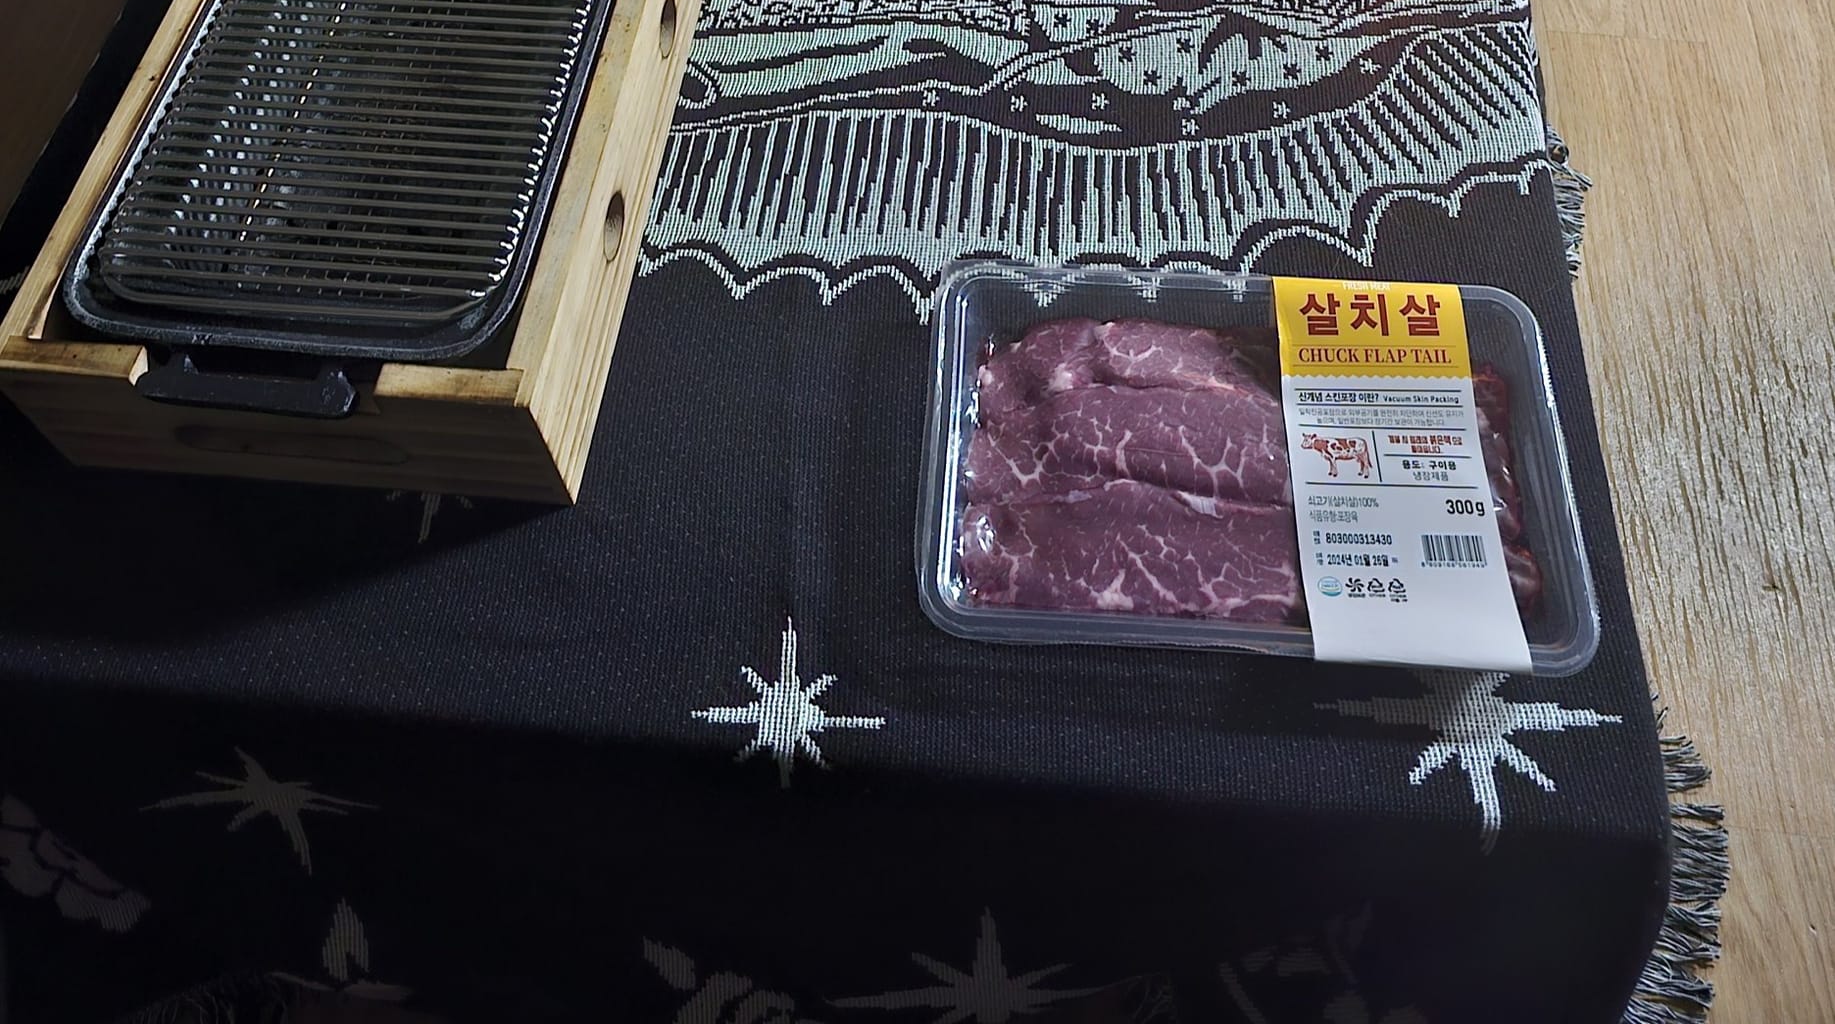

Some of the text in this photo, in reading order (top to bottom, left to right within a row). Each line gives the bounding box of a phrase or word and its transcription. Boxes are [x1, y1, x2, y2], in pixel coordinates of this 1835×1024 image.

[1299, 293, 1441, 337] 살치살
[1298, 347, 1452, 364] CHUCK FLAP TAIL
[1298, 392, 1459, 404] 신개념 스킨포장 이란? Vacuum Skin Packing
[1402, 460, 1457, 470] 용도: 구이용
[1412, 471, 1449, 481] 냉장제품
[1445, 499, 1486, 517] 300g
[1325, 532, 1393, 546] 803000313430
[1327, 554, 1352, 567] 2024년
[1354, 555, 1371, 567] 01월
[1372, 555, 1389, 567] 26일
